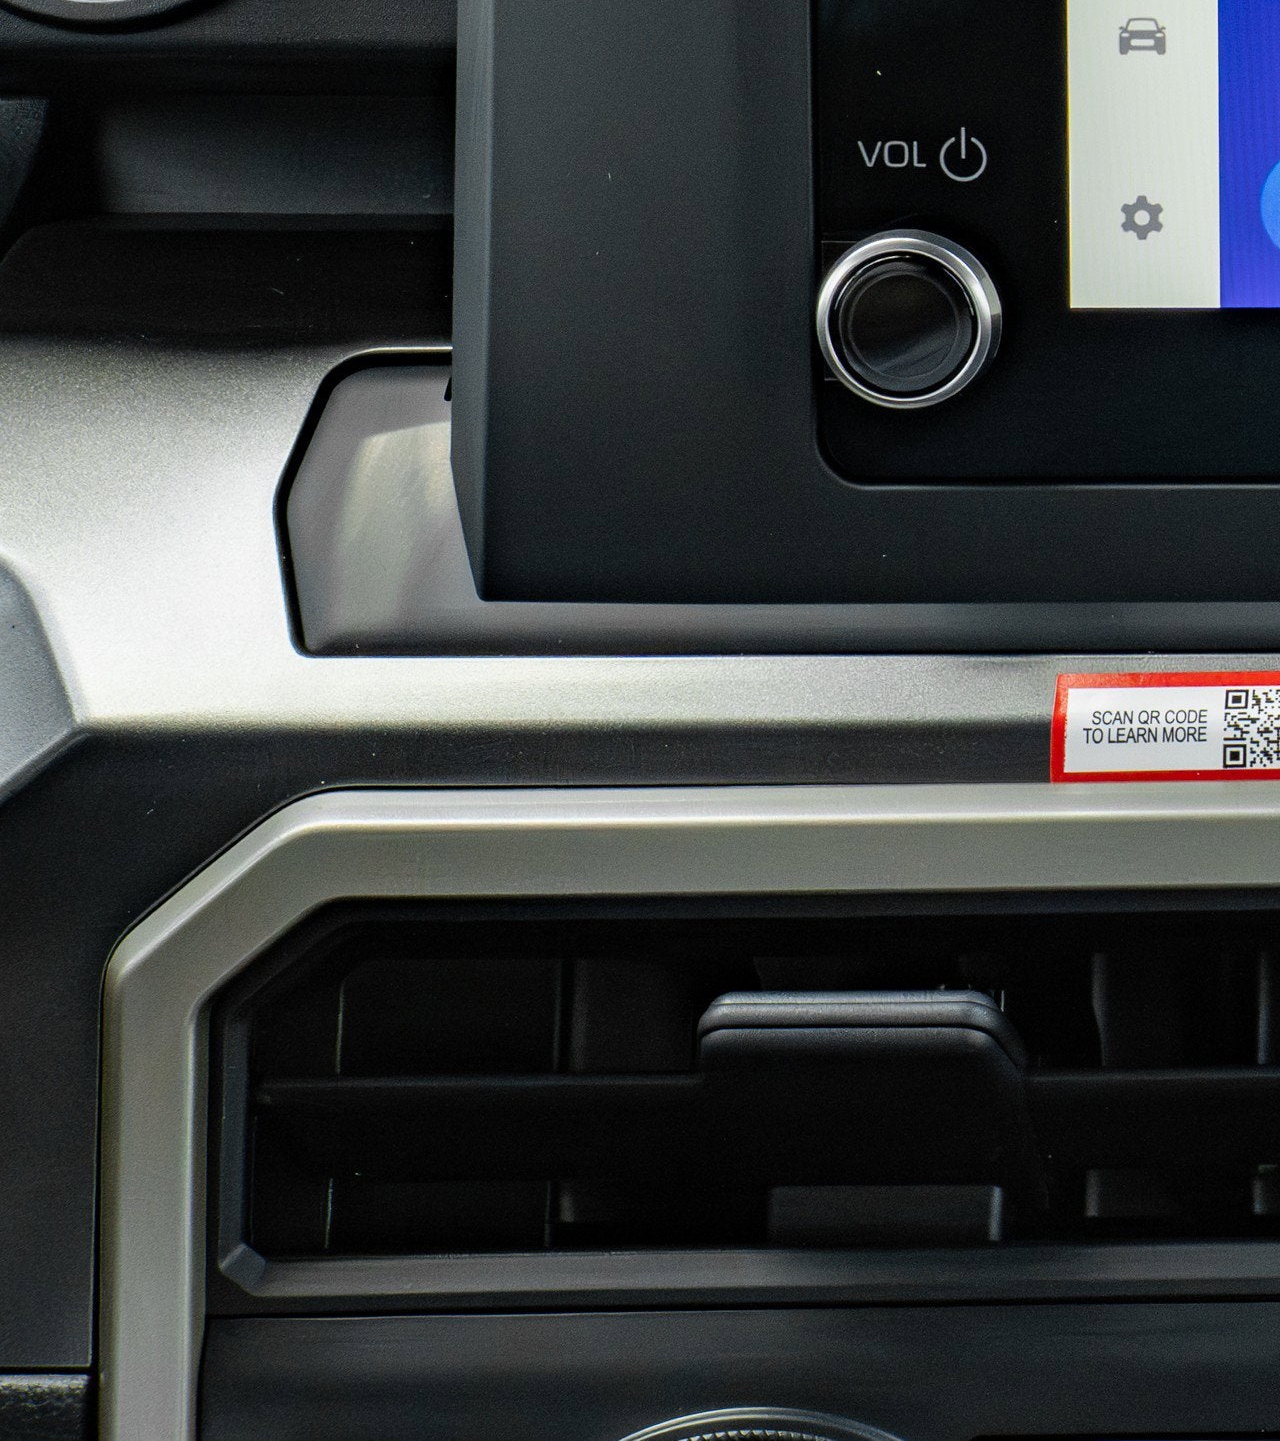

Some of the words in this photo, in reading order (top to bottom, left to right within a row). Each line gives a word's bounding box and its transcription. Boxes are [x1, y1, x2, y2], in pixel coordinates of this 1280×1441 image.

[857, 140, 927, 168] VOL
[1091, 710, 1134, 725] SCAN
[1137, 710, 1161, 726] QR
[1164, 709, 1208, 724] CODE
[1082, 728, 1104, 744] TO
[1108, 727, 1158, 744] LEARN
[1162, 726, 1208, 743] MORE
